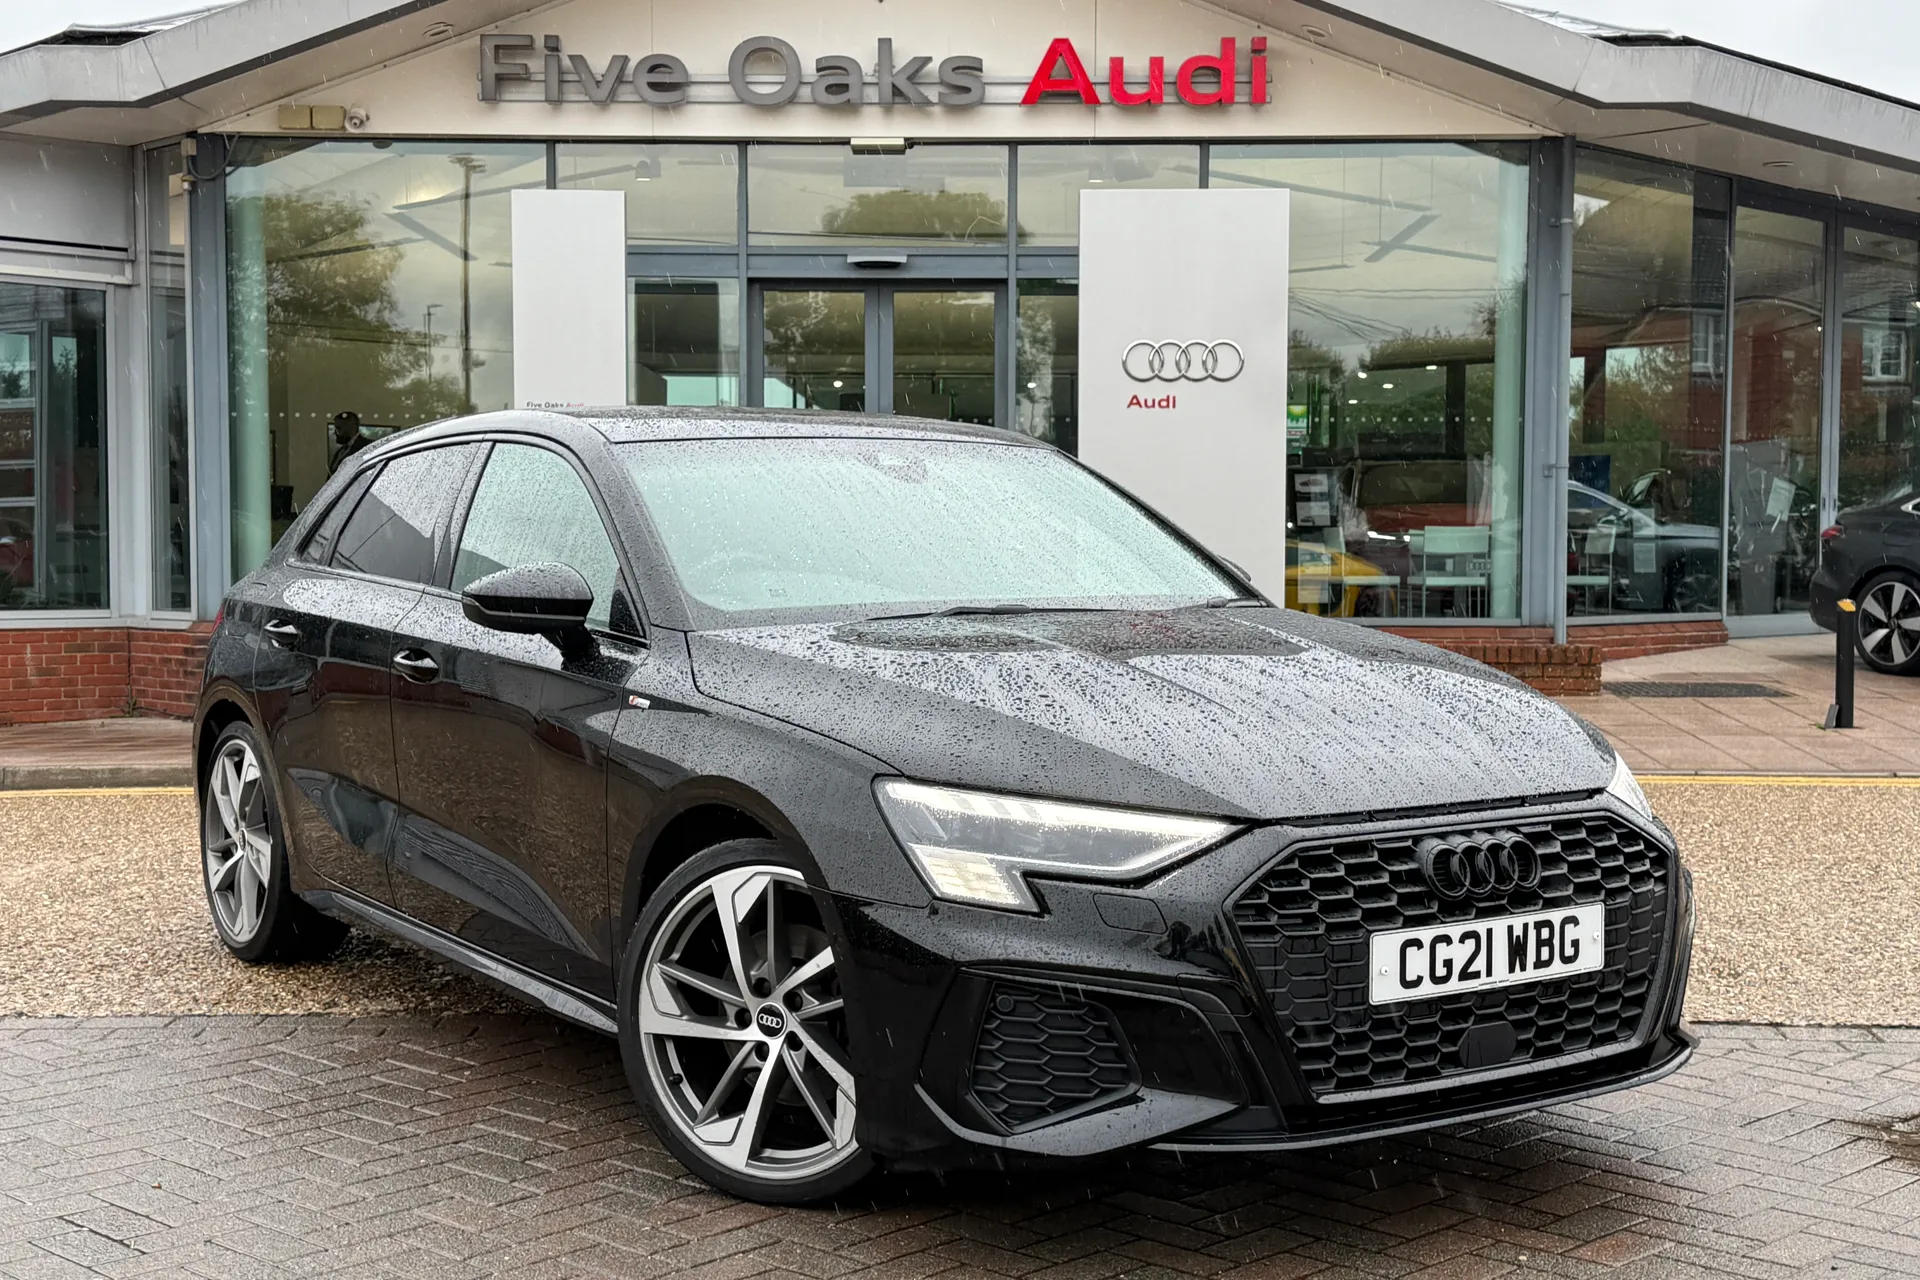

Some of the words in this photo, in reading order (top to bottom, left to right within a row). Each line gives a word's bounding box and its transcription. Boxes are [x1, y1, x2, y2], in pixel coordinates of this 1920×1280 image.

[479, 34, 689, 106] Five
[727, 36, 985, 107] Oaks
[1020, 36, 1268, 106] Audi
[1127, 394, 1177, 409] Audi
[1399, 927, 1494, 990] CG21
[1506, 915, 1581, 974] WBG
